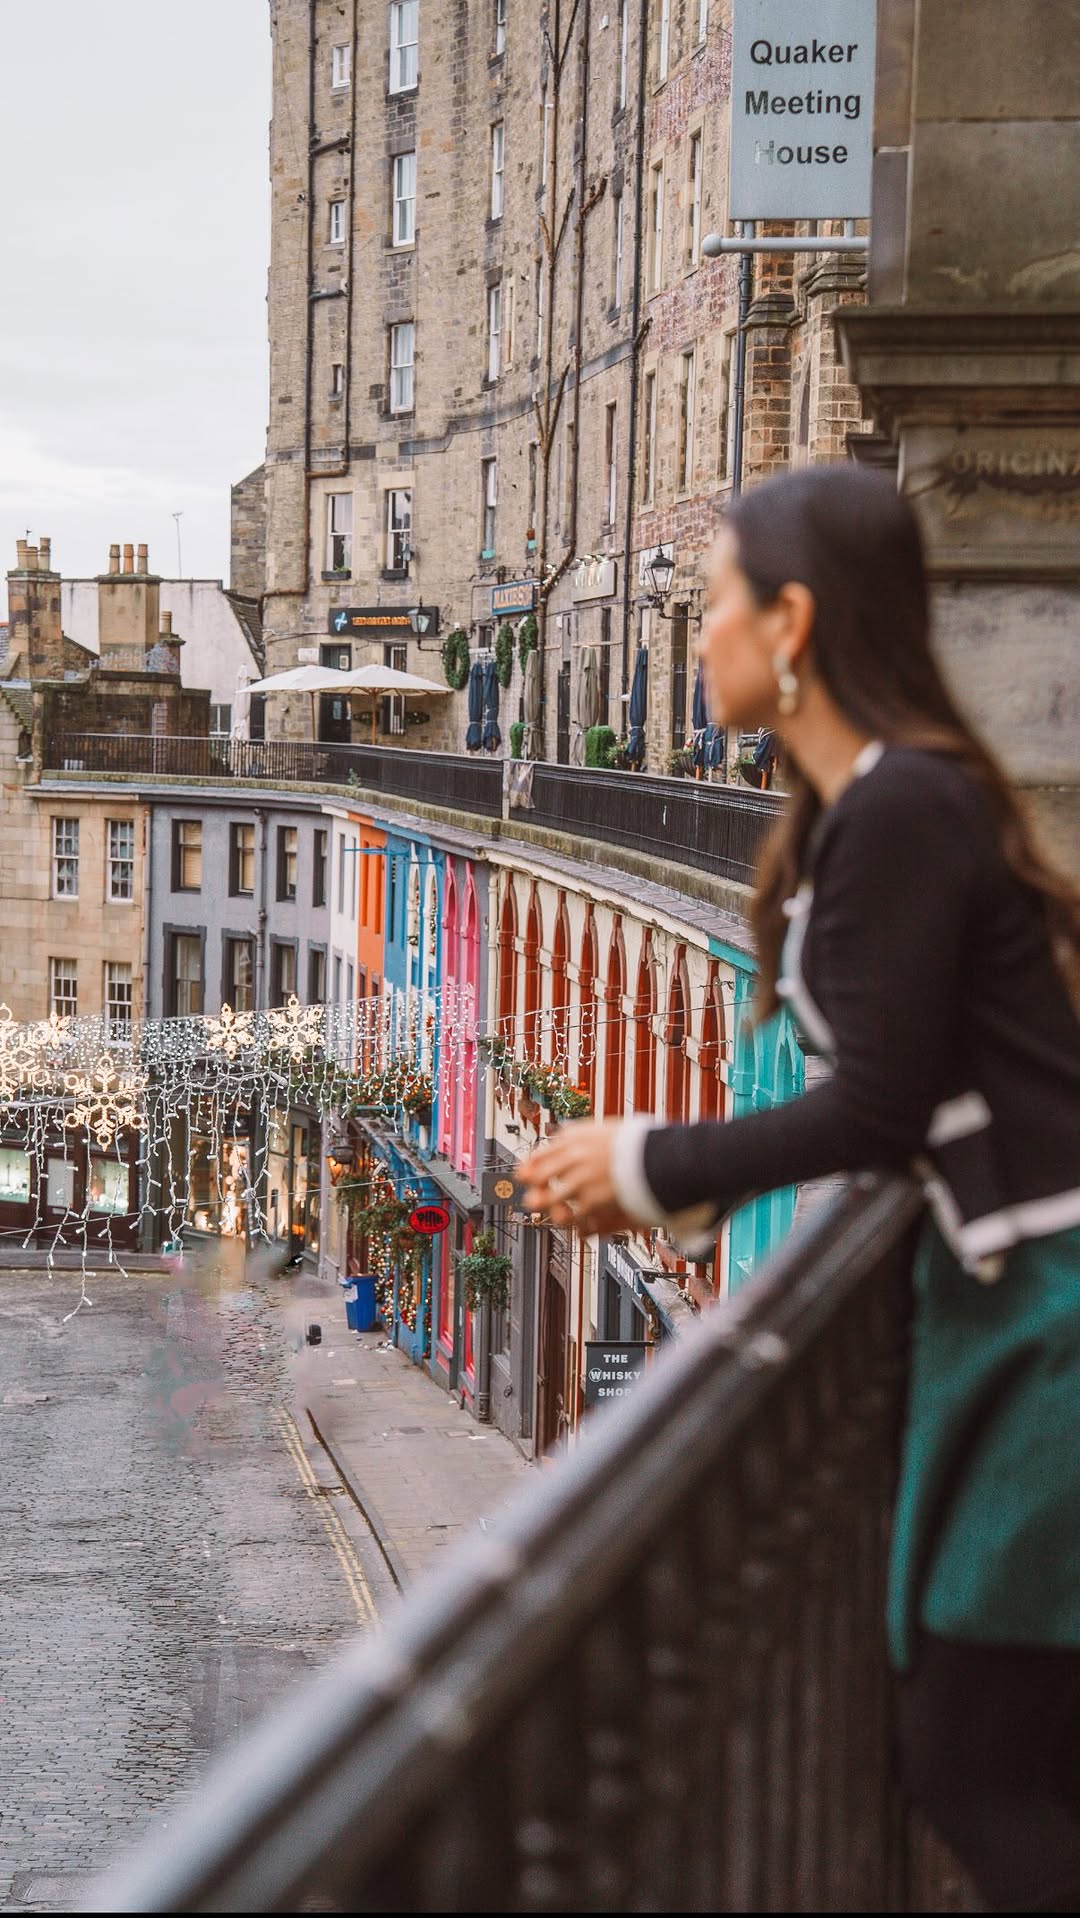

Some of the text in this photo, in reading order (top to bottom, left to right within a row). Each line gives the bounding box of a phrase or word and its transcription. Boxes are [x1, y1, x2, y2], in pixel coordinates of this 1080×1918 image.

[750, 39, 858, 66] Quaker
[745, 89, 861, 120] Meeting
[754, 140, 848, 165] House
[603, 1354, 629, 1364] THE
[589, 1369, 641, 1381] WHISKY
